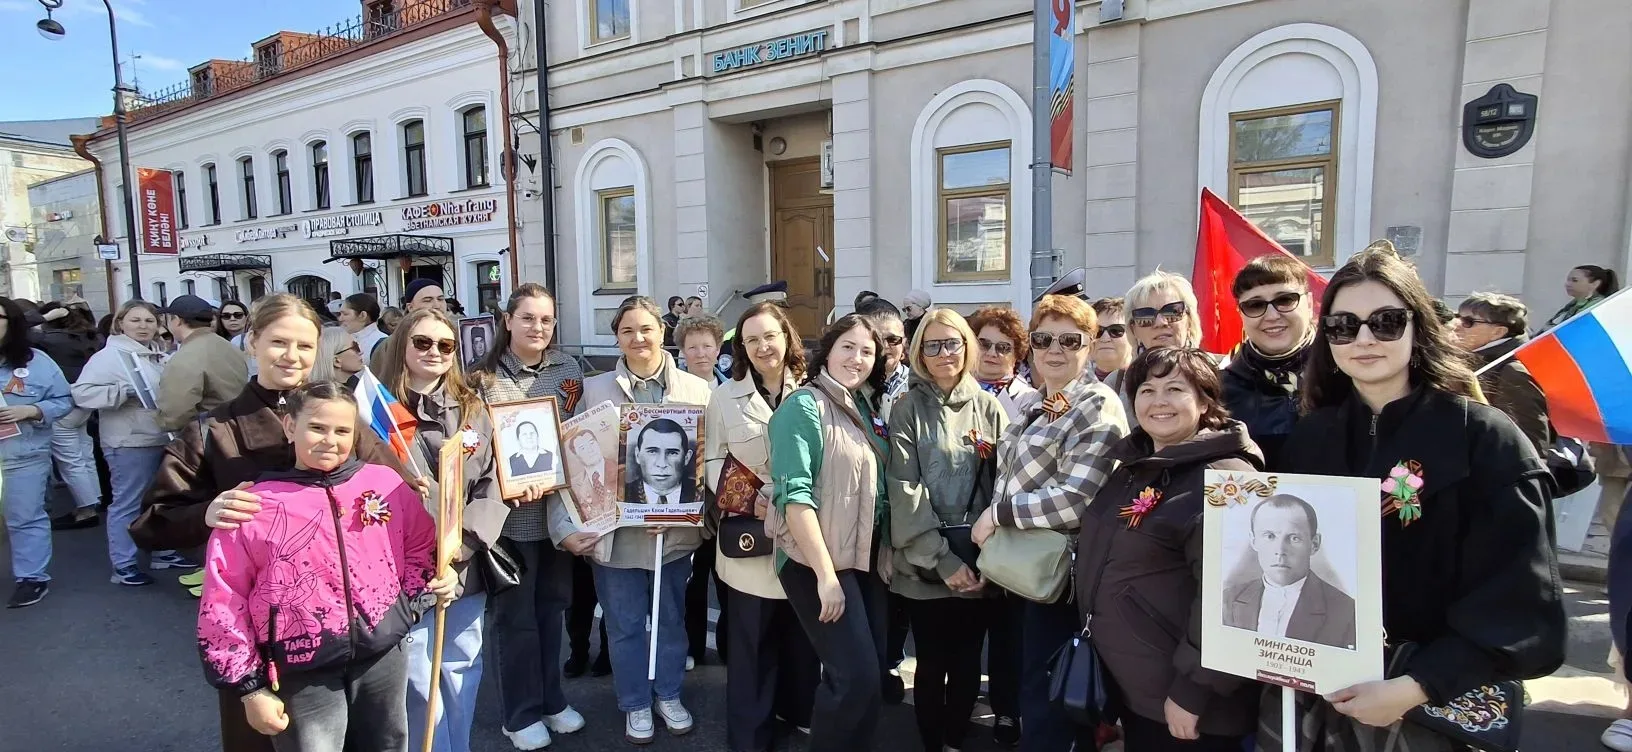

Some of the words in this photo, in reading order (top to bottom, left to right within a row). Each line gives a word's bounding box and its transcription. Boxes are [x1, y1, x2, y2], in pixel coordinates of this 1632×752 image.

[713, 45, 761, 72] БАНК
[766, 31, 827, 61] ЗЕНИТ
[401, 205, 428, 220] КАФЕ
[440, 201, 460, 215] Nha
[311, 215, 346, 231] ПРАВОВАЯ
[346, 211, 382, 227] СТОЛИЦА
[407, 216, 459, 230] ВЬЕТНАМСКАЯ
[461, 212, 489, 224] КУХНЯ
[643, 407, 686, 415] Бессмертный
[284, 639, 311, 651] TAKE
[1254, 638, 1316, 657] МИНГАЗОВ
[287, 650, 315, 663] EASY
[1258, 649, 1313, 668] ЗИГАНША
